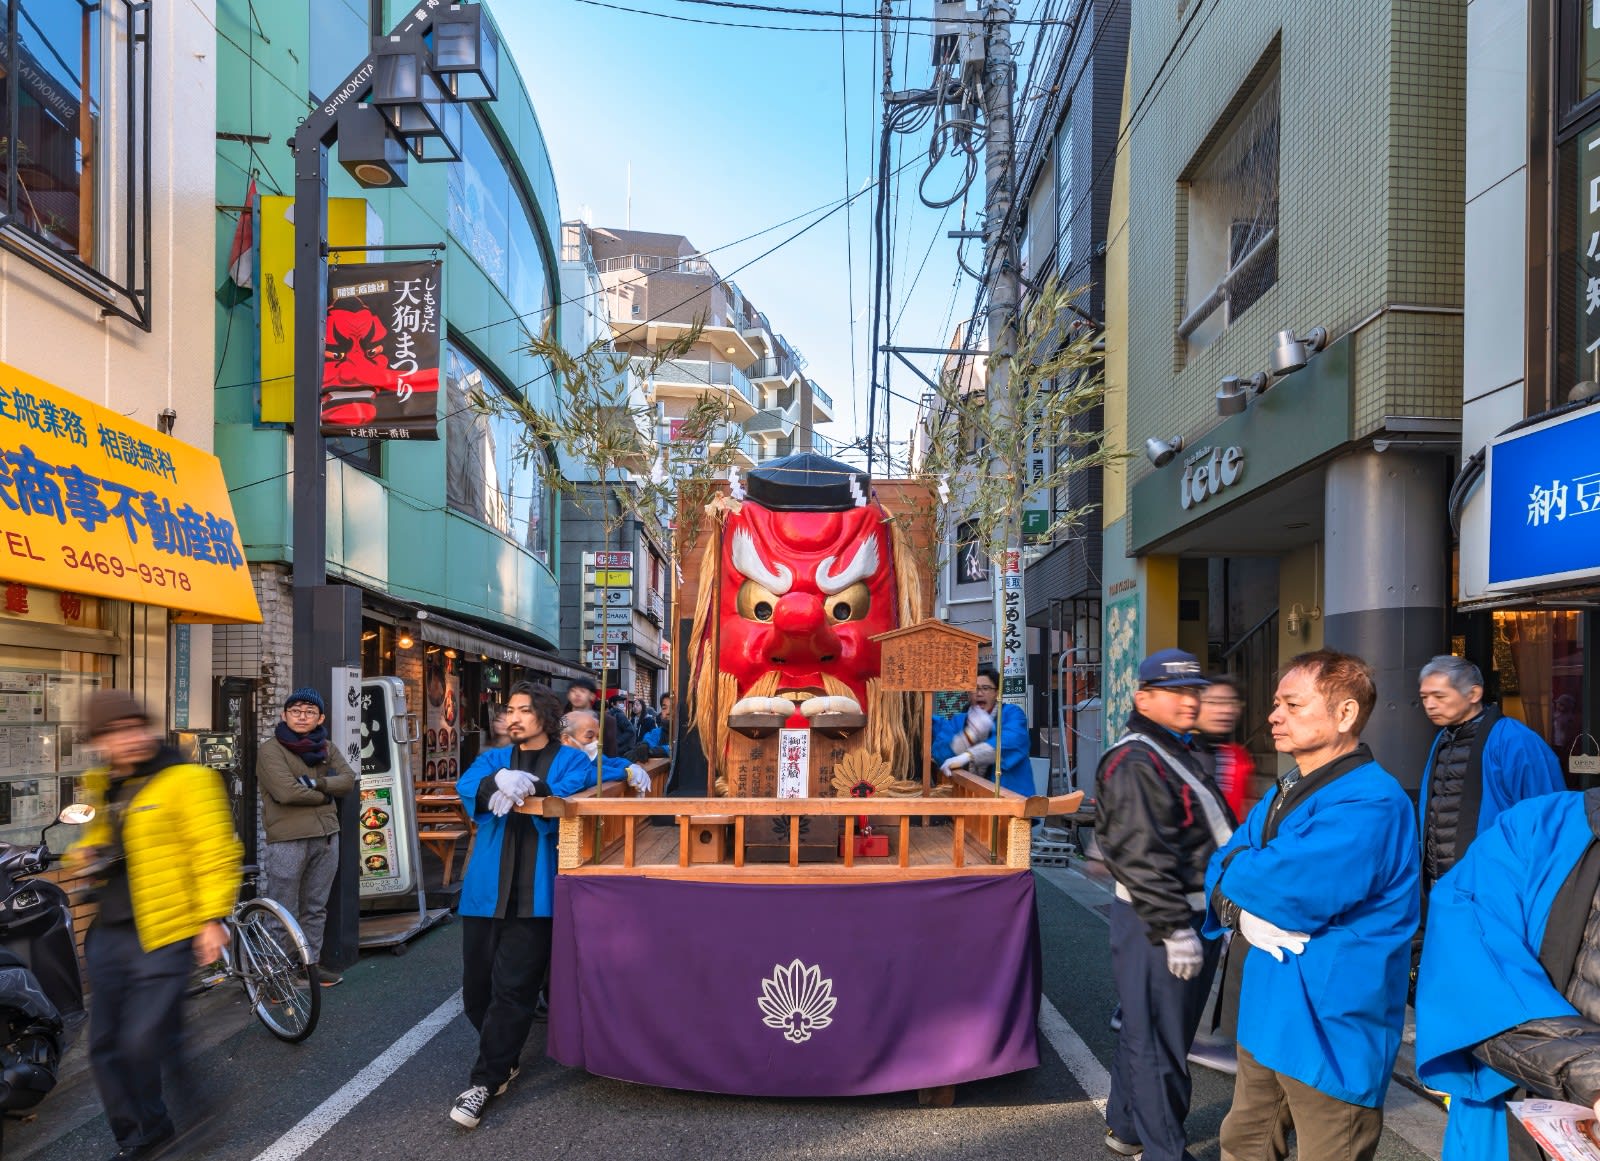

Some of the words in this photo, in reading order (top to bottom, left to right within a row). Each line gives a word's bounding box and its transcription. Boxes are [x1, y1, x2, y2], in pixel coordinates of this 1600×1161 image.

[324, 61, 376, 116] SHIMOKITA
[421, 278, 436, 333] しもきた
[390, 278, 422, 404] 天狗まつり
[97, 423, 178, 484] 相談無料
[346, 428, 410, 438] 下北沢一番街
[0, 444, 244, 571] 商事不動産部
[61, 545, 193, 592] 3469-9378
[1004, 591, 1022, 654] ともえや
